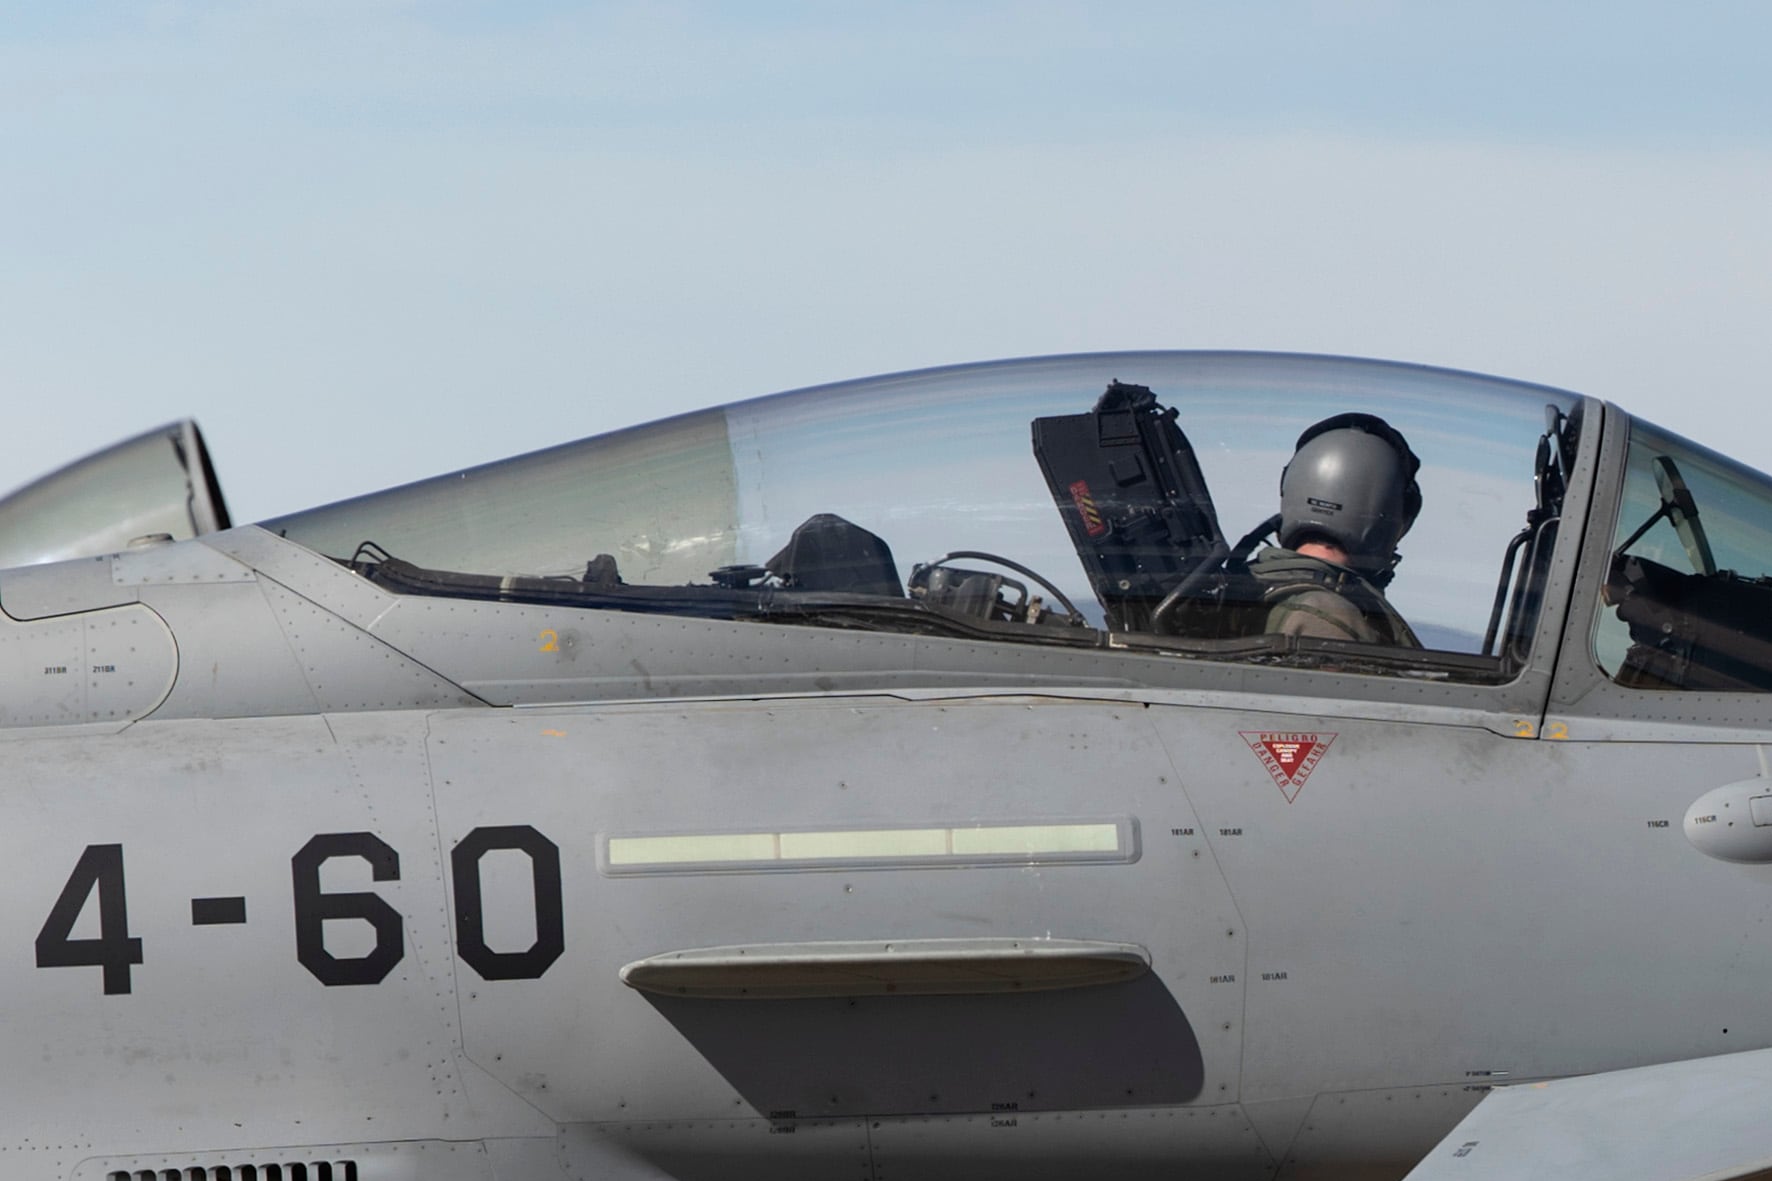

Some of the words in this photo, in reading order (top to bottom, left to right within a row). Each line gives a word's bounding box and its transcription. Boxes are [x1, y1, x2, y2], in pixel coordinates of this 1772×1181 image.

[1260, 734, 1318, 742] PELIGRO
[1252, 742, 1290, 787] DANGER
[1291, 742, 1328, 786] GEFAHR
[35, 825, 565, 995] 4-60
